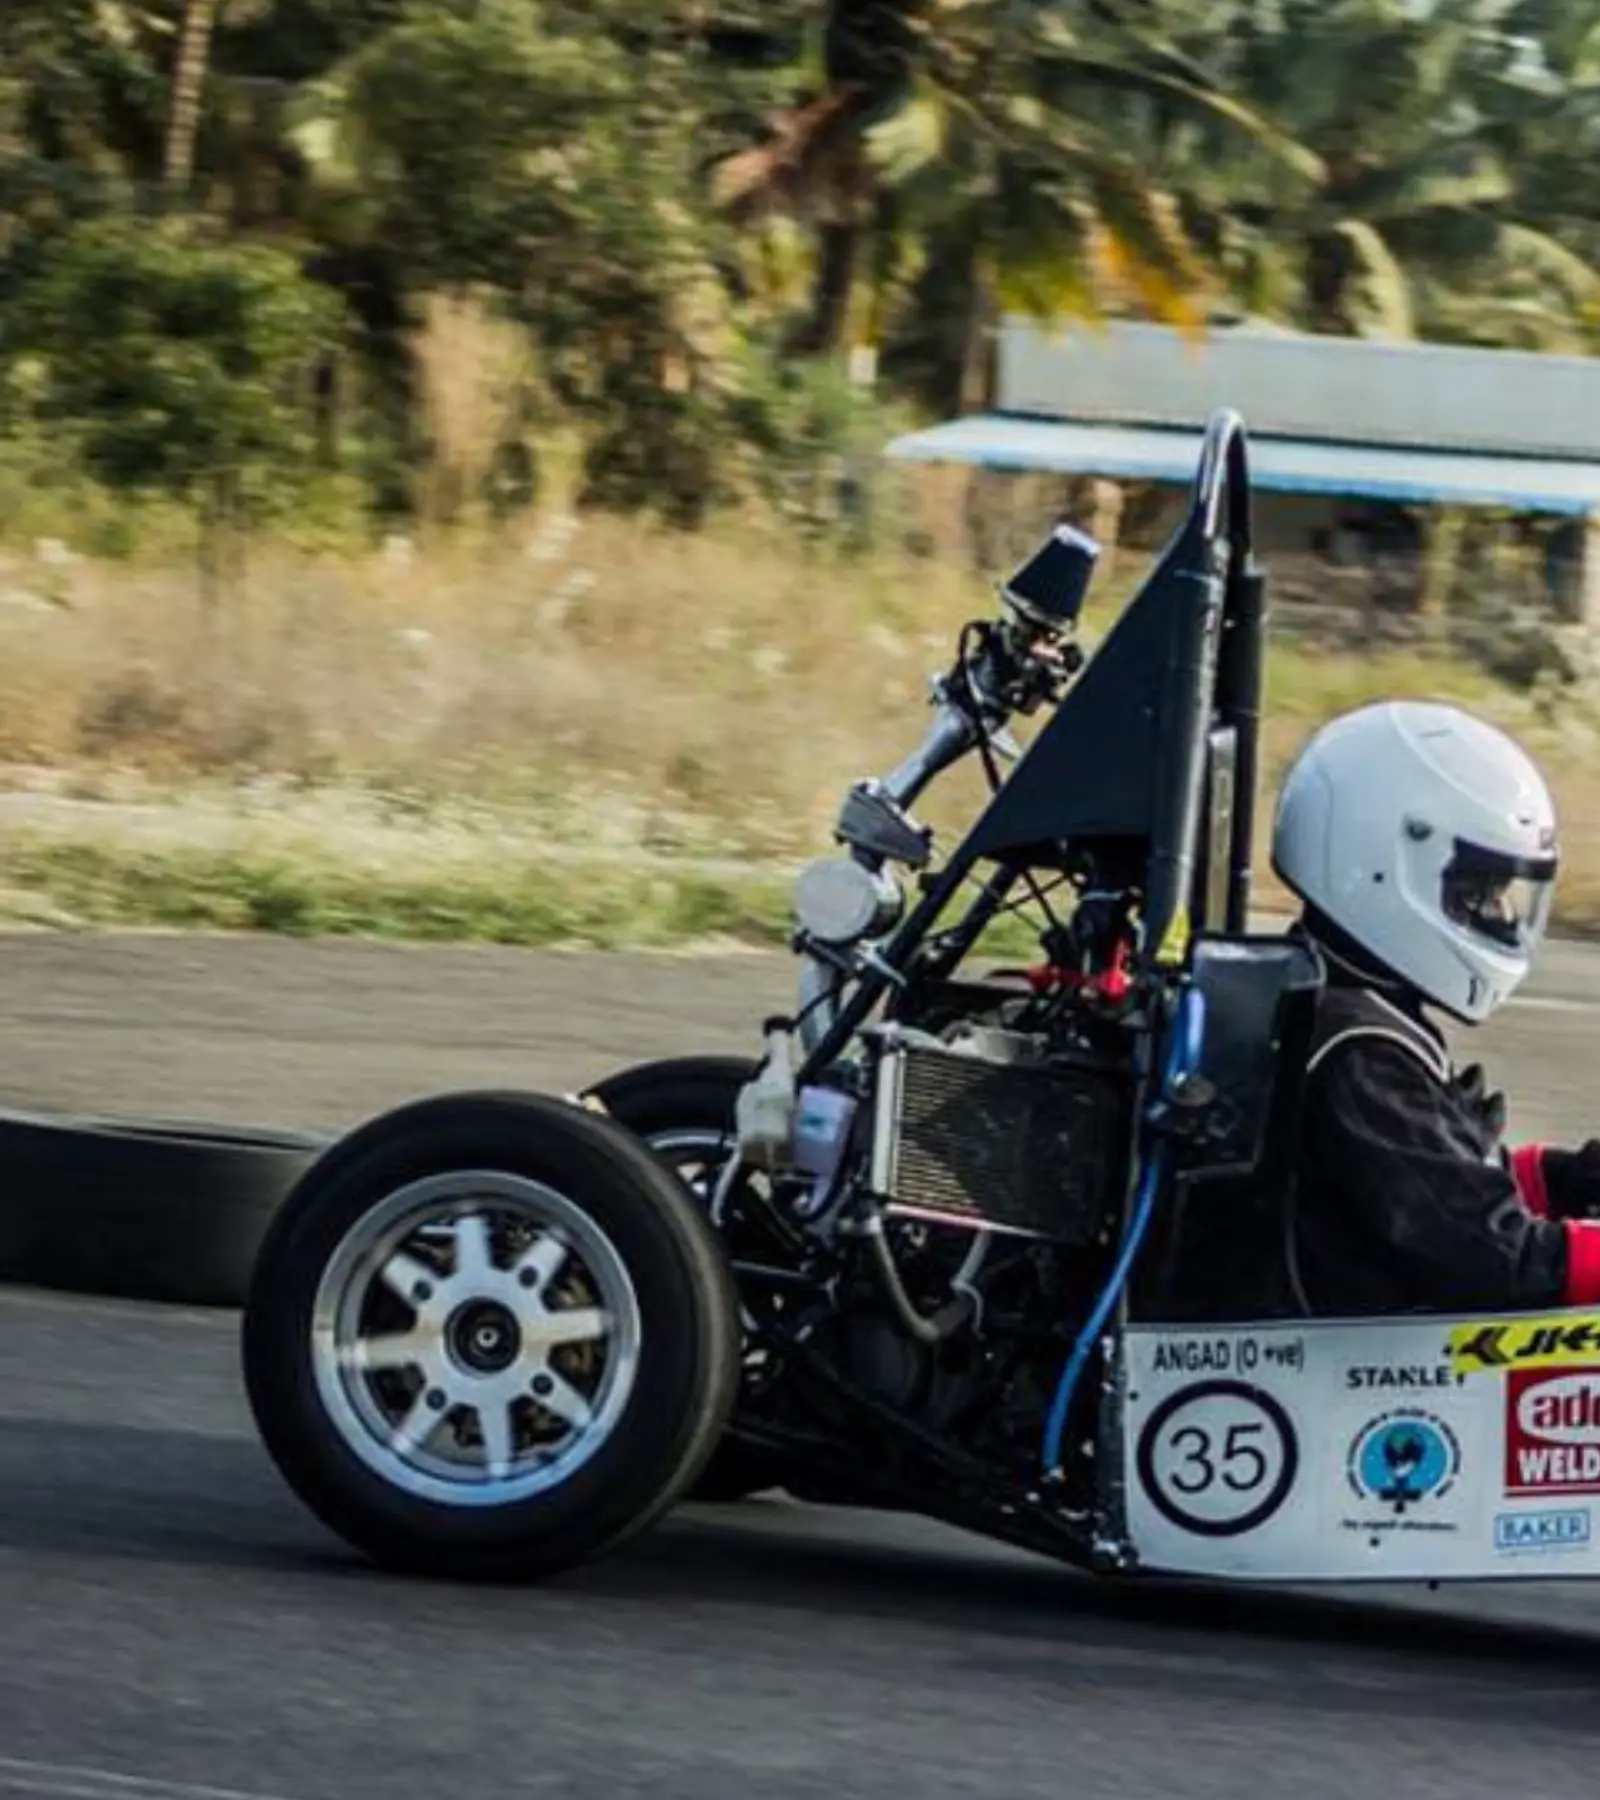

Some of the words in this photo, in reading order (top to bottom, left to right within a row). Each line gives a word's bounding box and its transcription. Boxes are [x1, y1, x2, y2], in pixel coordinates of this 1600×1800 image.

[1153, 1339, 1231, 1371] ANGAD
[1170, 1423, 1266, 1493] 35
[1503, 1515, 1581, 1542] BAKER
